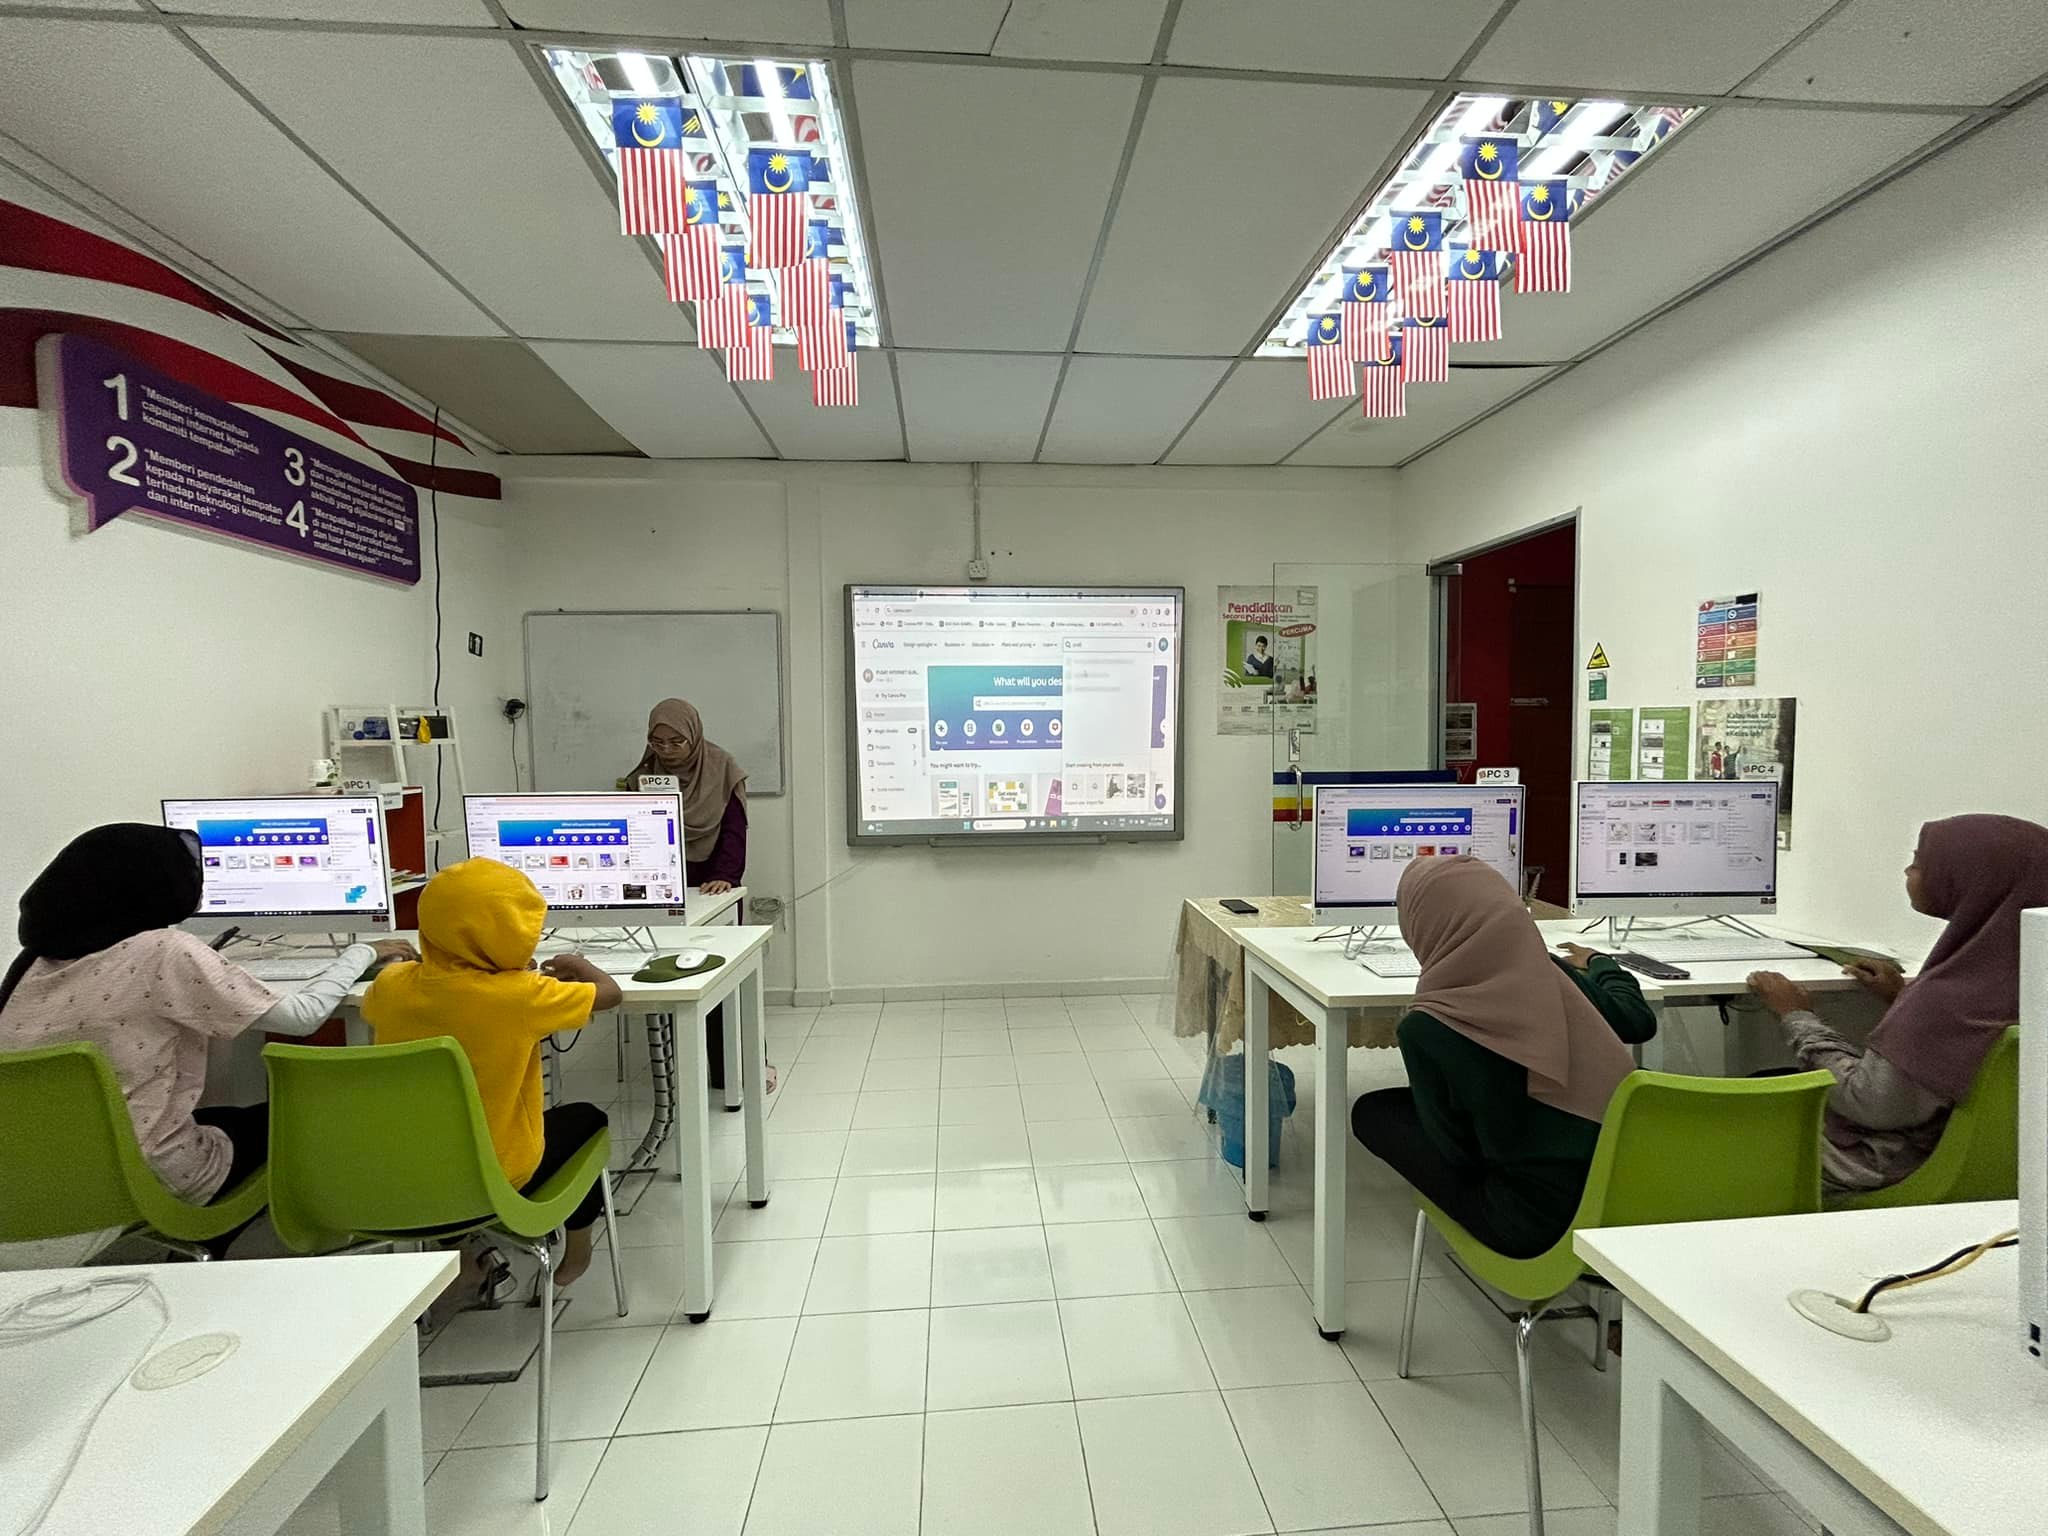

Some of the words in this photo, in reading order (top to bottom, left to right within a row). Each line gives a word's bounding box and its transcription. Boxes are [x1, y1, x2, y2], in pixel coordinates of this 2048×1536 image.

[104, 374, 128, 420] 1
[186, 415, 225, 440] internet
[106, 435, 140, 486] 2
[284, 447, 305, 486] 3
[145, 460, 185, 485] kepada
[186, 476, 241, 502] masyarakat
[242, 494, 283, 515] tempatan
[146, 475, 195, 499] terhadap
[196, 491, 240, 515] teknologi
[241, 507, 282, 526] komputer
[147, 490, 168, 504] dan
[286, 500, 309, 537] 4
[1228, 602, 1293, 614] Pendidikan
[1246, 613, 1279, 625] Digital
[993, 676, 1016, 687] What
[1017, 676, 1030, 687] will
[1031, 678, 1046, 689] you
[1487, 770, 1501, 778] PC
[1504, 770, 1509, 778] 3
[1751, 765, 1766, 773] PC
[350, 781, 364, 789] PC
[366, 780, 371, 788] 1
[648, 777, 662, 785] PC
[664, 777, 670, 785] 2
